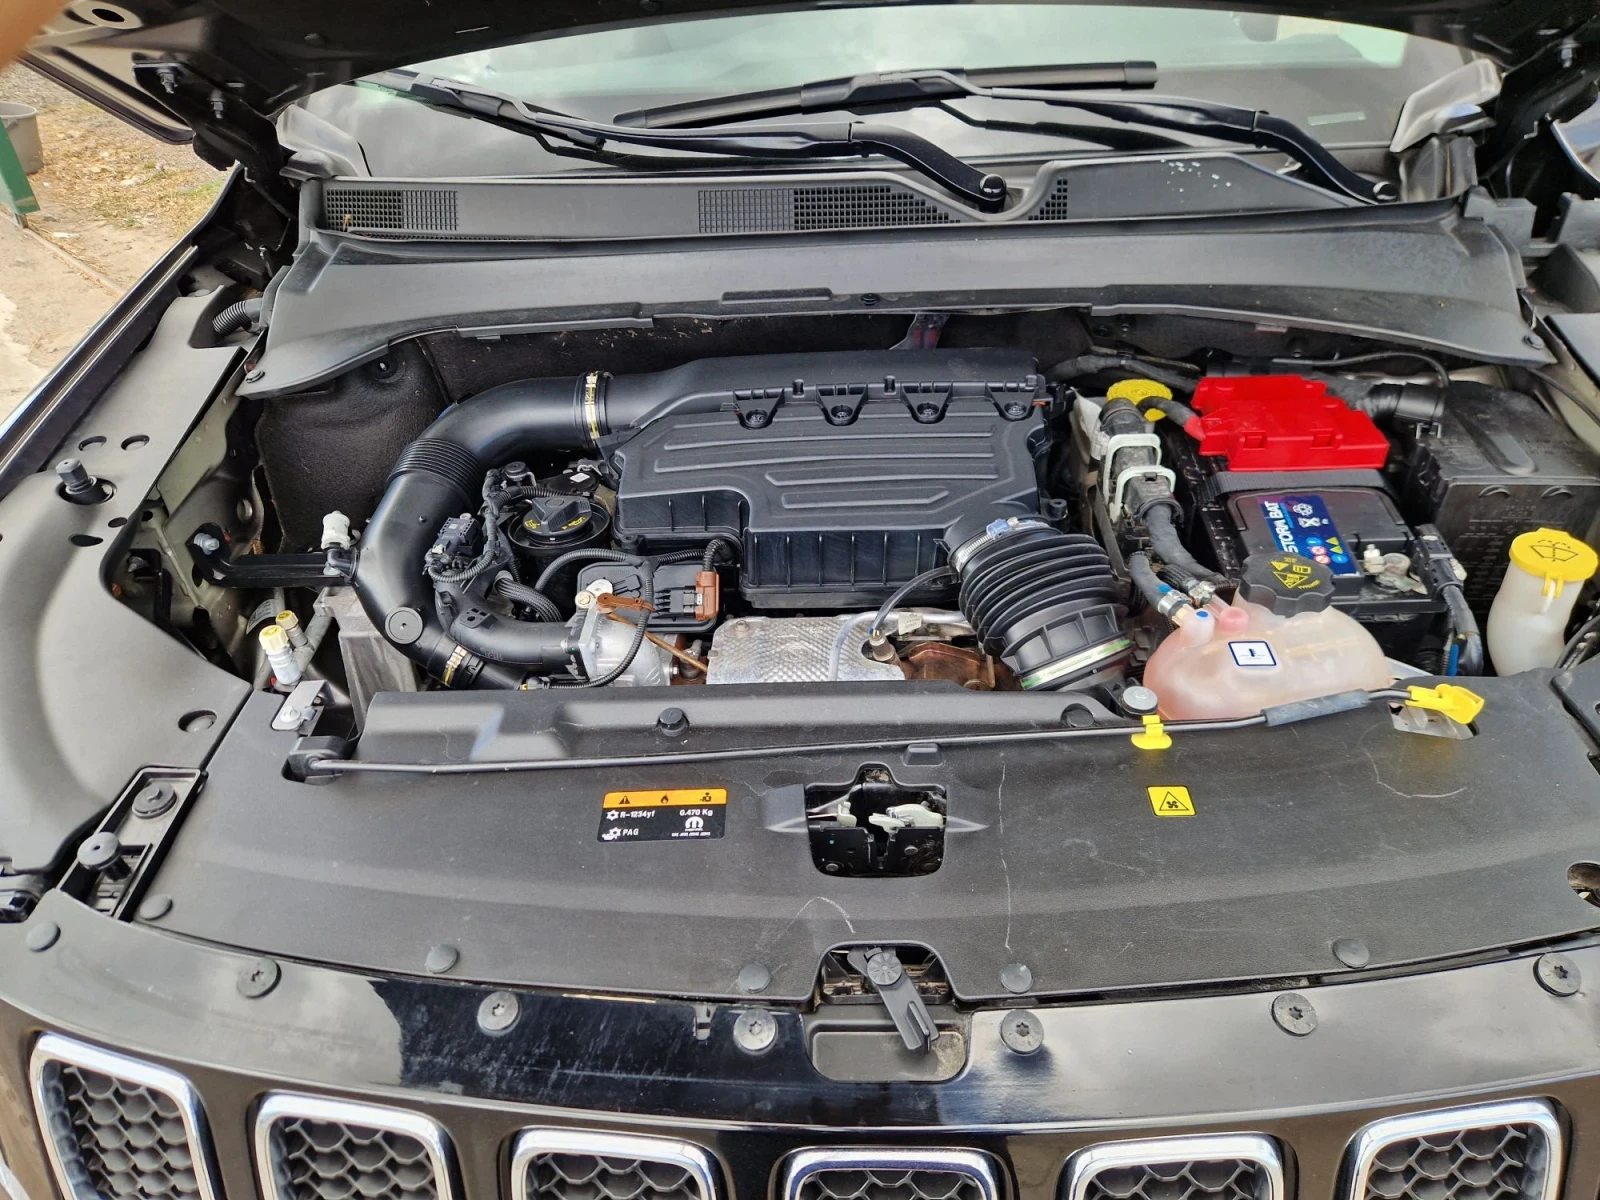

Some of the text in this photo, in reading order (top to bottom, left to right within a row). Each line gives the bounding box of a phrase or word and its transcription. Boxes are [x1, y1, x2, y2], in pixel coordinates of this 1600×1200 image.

[1264, 501, 1284, 518] BAT
[1273, 519, 1299, 553] STORM
[620, 810, 656, 818] R-1234yf
[702, 808, 713, 817] Kg
[622, 828, 639, 836] PAG
